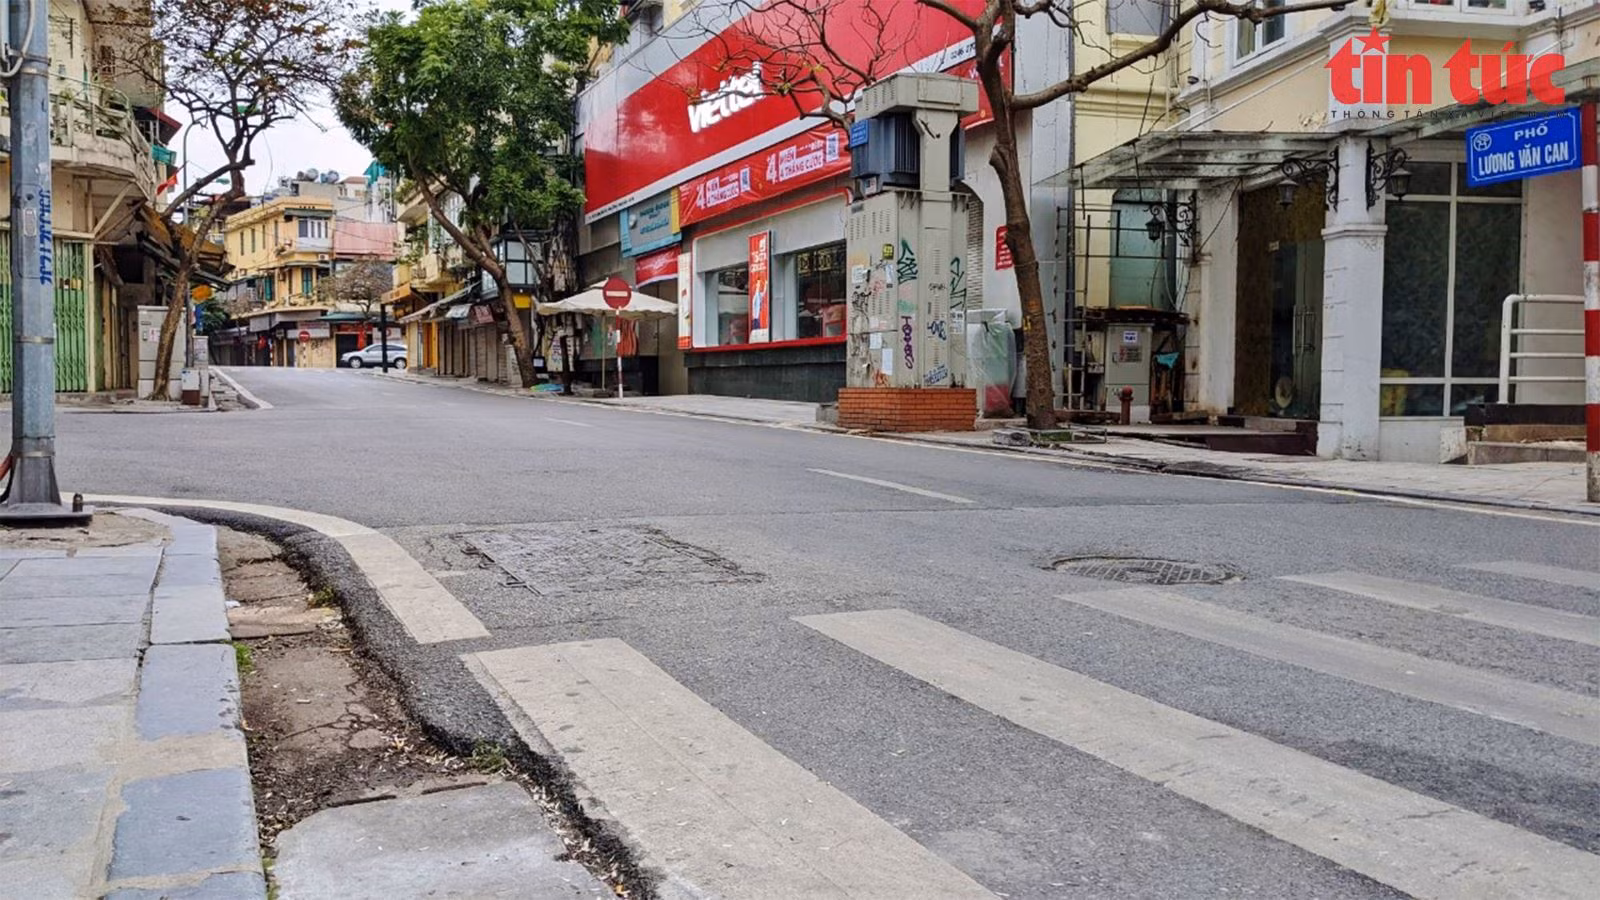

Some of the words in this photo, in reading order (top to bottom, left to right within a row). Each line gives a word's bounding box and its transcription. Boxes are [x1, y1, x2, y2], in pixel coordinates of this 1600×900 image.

[1514, 120, 1548, 141] PHỐ
[1478, 152, 1514, 176] LƯƠNG
[1519, 143, 1541, 168] VĂN
[1544, 141, 1568, 163] CAN
